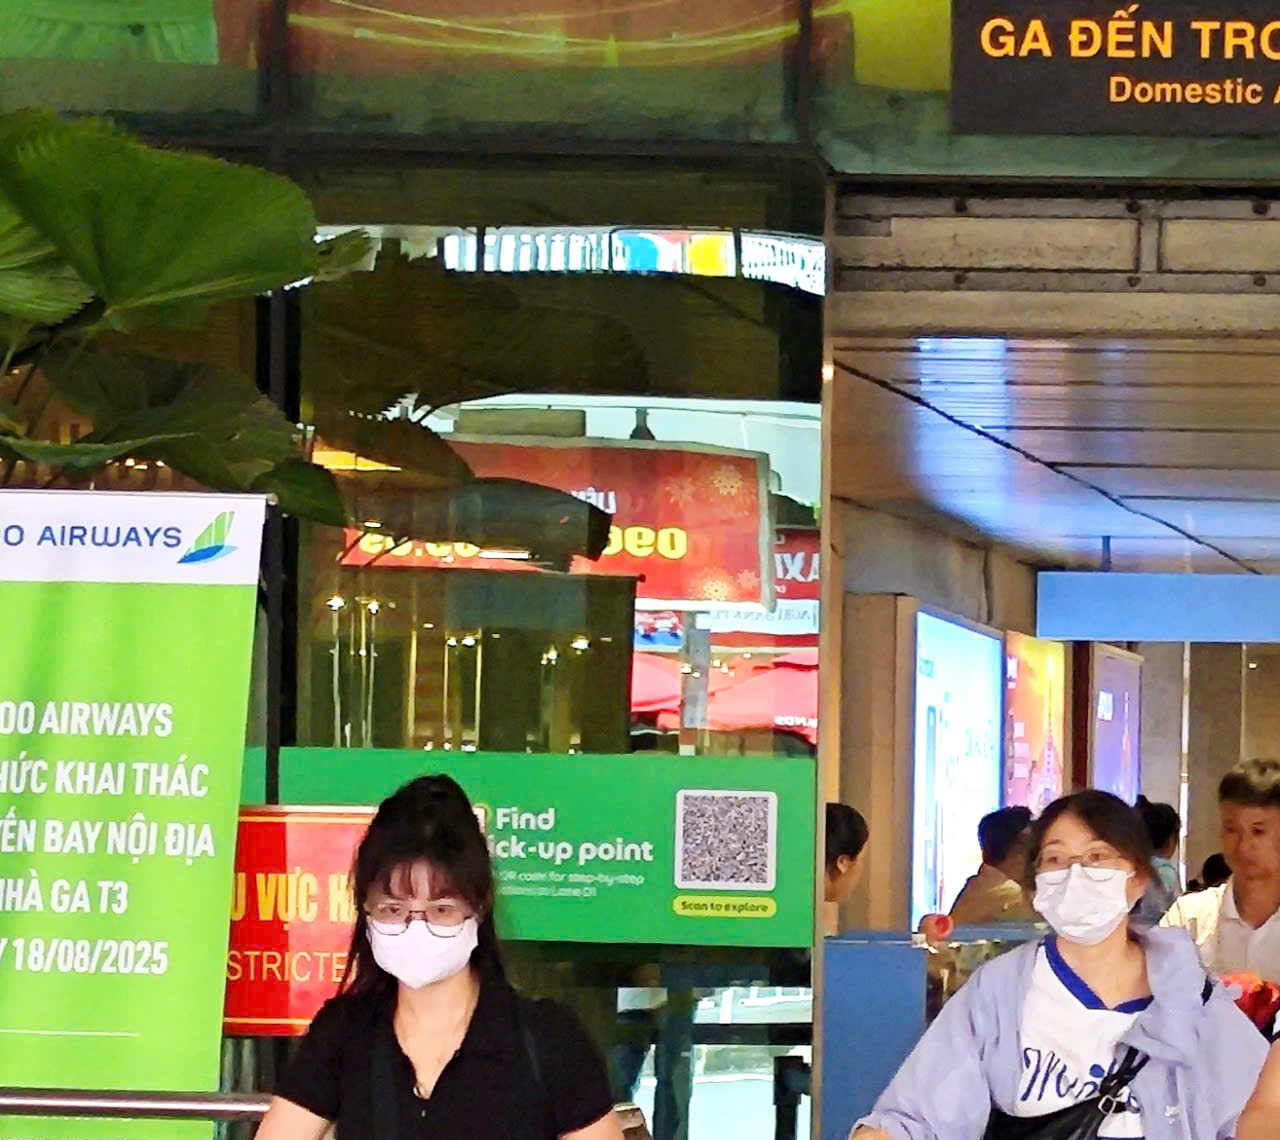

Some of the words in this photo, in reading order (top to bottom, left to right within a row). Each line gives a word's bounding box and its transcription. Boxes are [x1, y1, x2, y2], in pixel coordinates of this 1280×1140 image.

[980, 19, 1051, 58] GA
[1069, 3, 1173, 60] ĐẾN
[1109, 77, 1263, 105] Domestic
[37, 525, 182, 548] AIRWAYS
[38, 701, 174, 737] AIRWAYS
[55, 760, 126, 796] KHAI
[132, 754, 209, 797] THÁC
[496, 806, 556, 831] Find
[43, 819, 103, 854] BAY
[107, 812, 158, 864] NỘI
[165, 822, 216, 866] ĐỊA
[487, 834, 573, 866] ick-up
[579, 838, 653, 866] point
[50, 879, 91, 913] GA
[97, 880, 128, 914] T3
[256, 866, 320, 931] VỰC
[681, 901, 709, 911] Scan
[711, 902, 723, 912] to
[724, 903, 768, 914] explore
[12, 937, 169, 975] 18/08/2025
[226, 951, 350, 983] STRICTE
